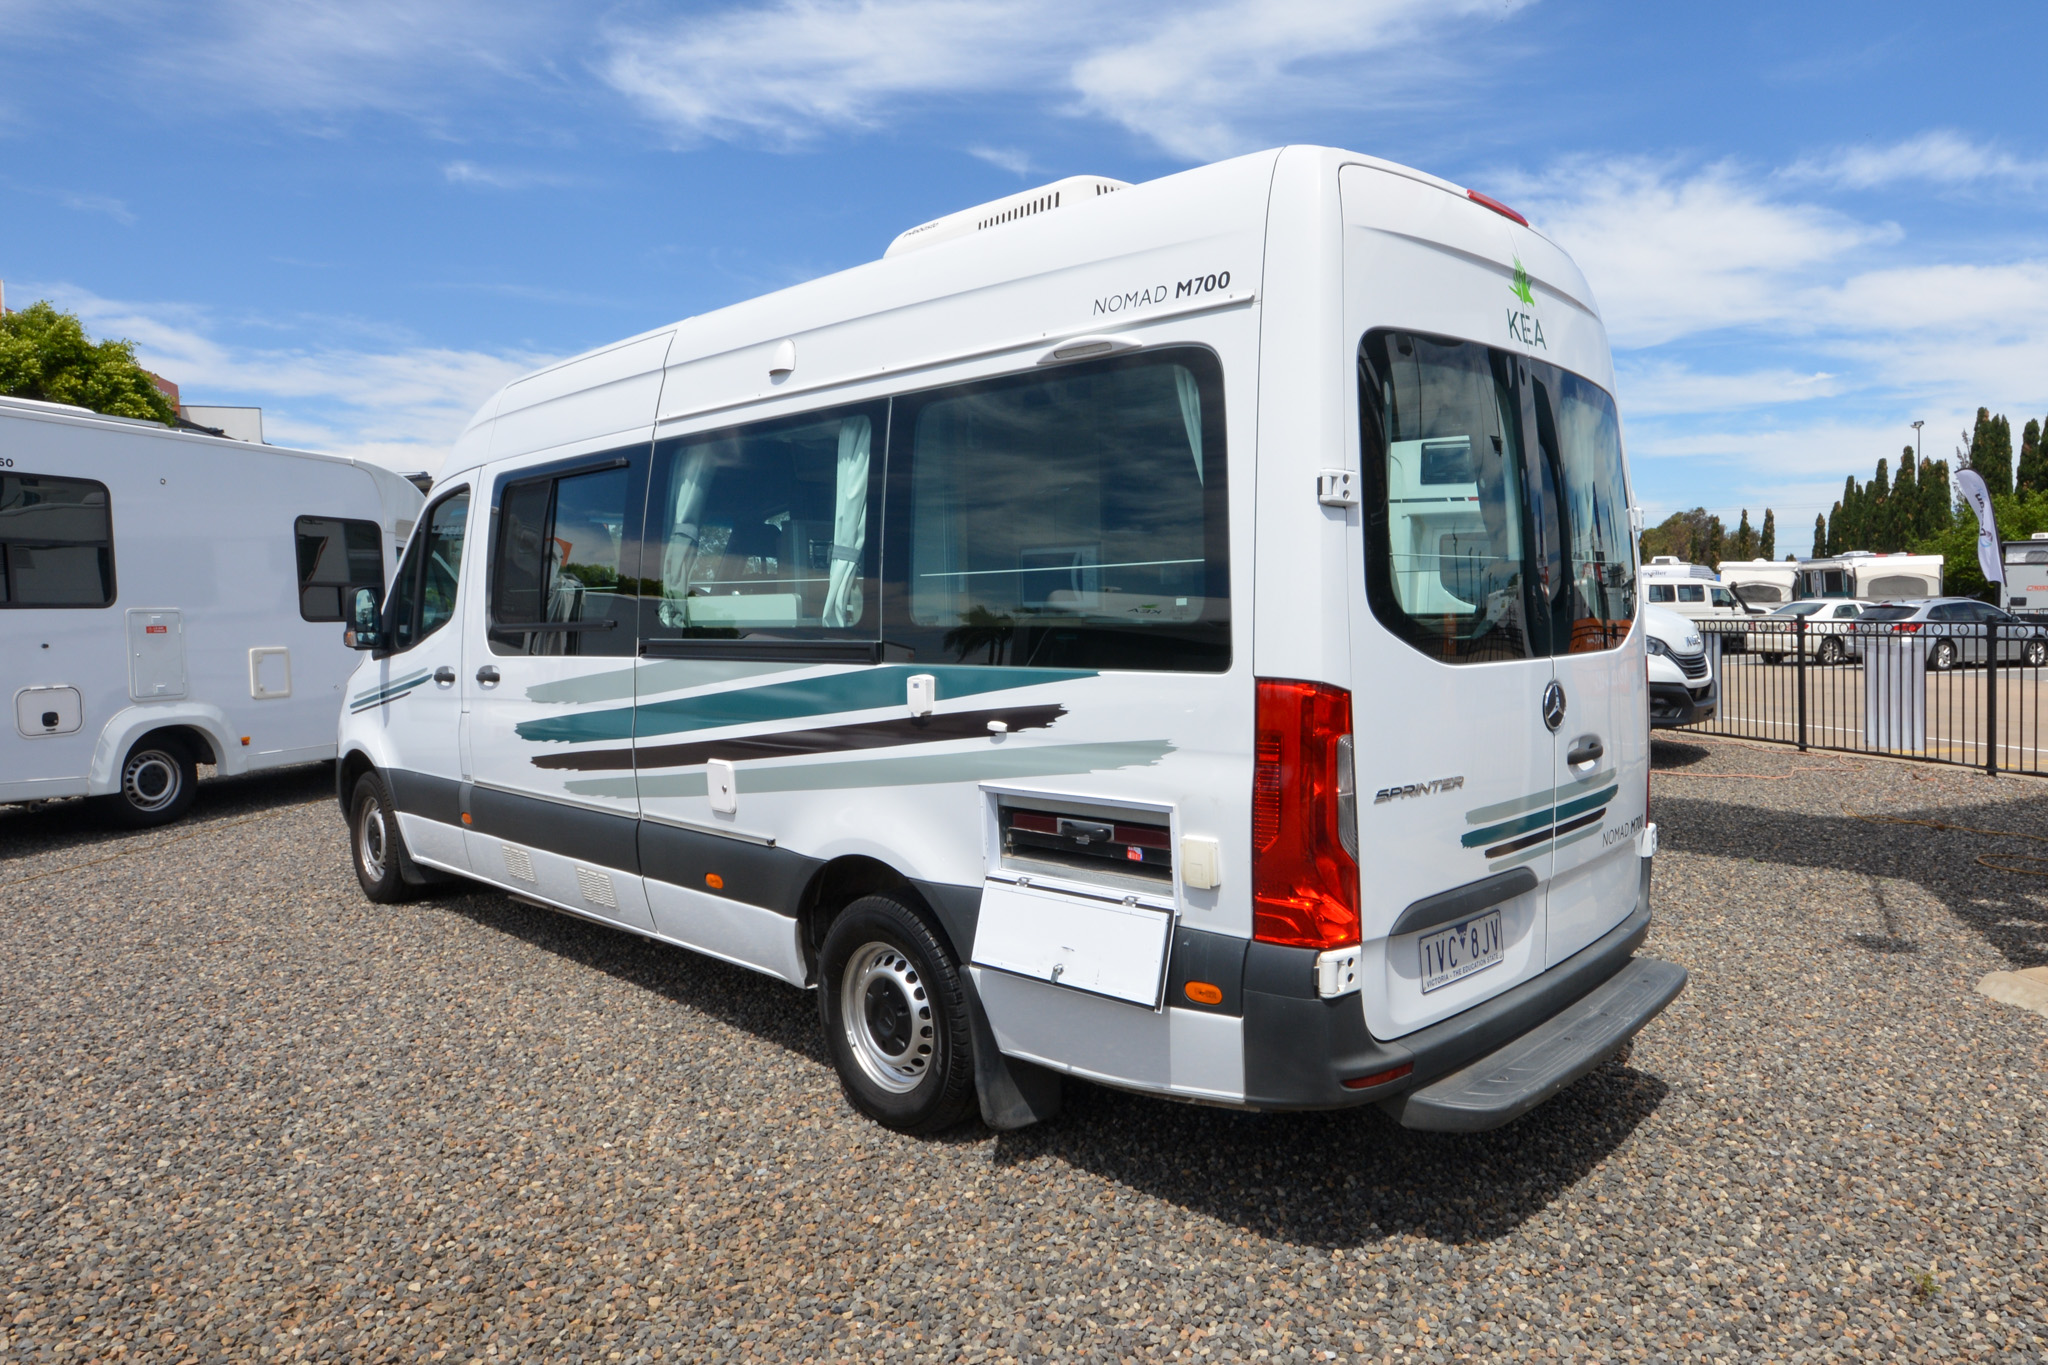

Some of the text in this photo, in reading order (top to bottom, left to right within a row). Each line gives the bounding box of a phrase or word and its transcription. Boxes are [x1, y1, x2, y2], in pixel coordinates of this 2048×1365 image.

[1093, 271, 1231, 316] NOMAD M700
[1506, 308, 1547, 350] KEA
[1374, 776, 1464, 805] SPRINTER
[1602, 822, 1629, 848] NOMAD
[1426, 918, 1498, 978] 1VC 8JV
[1426, 974, 1449, 988] VICTORIA
[1453, 968, 1462, 977] THE
[1462, 957, 1486, 974] EDUCATION
[1487, 952, 1499, 964] STATE
